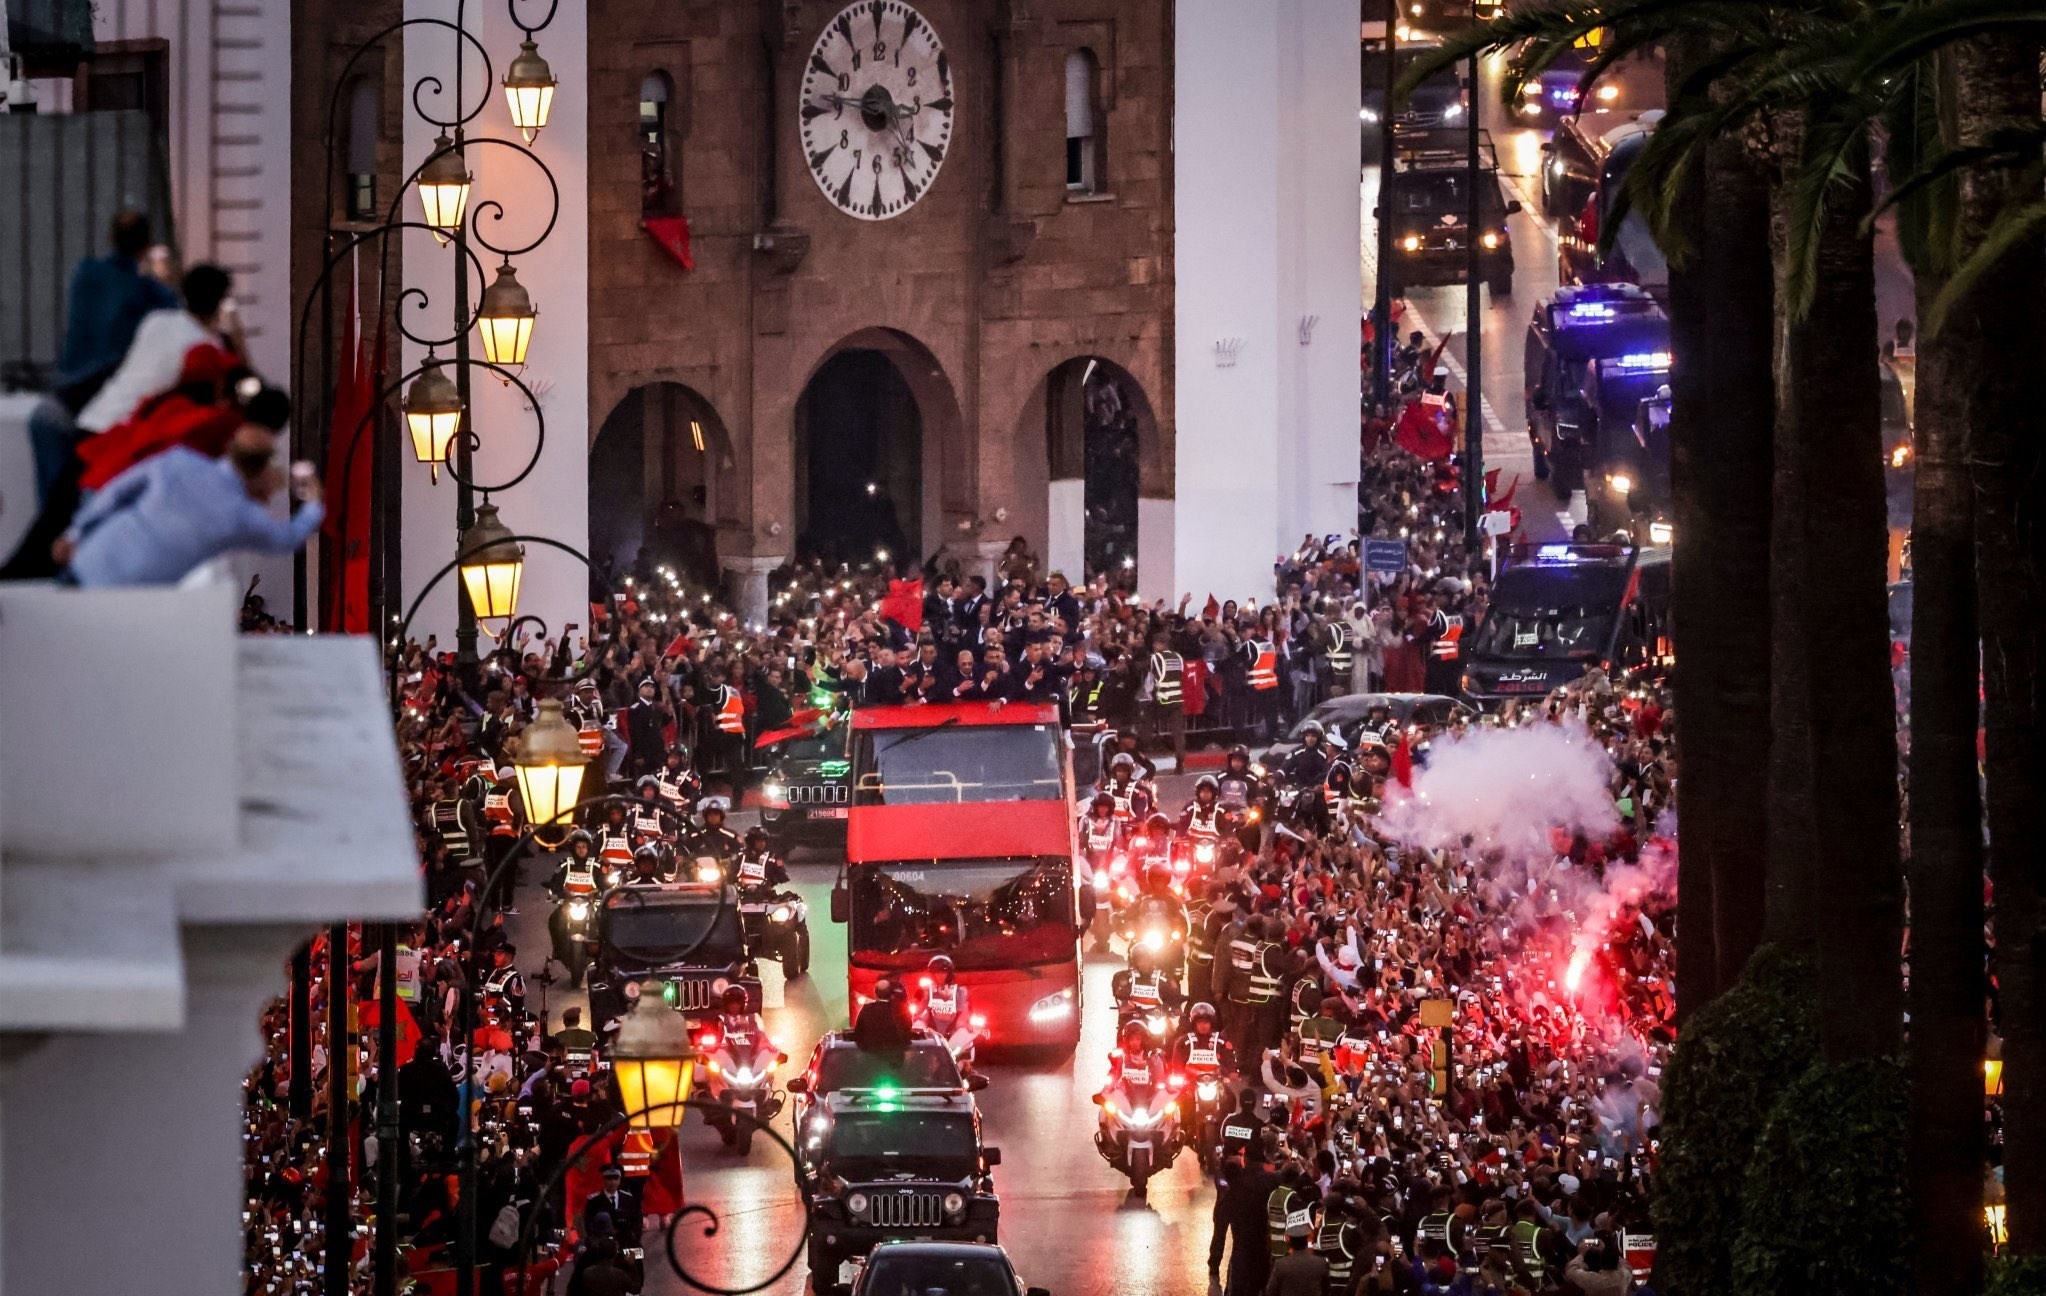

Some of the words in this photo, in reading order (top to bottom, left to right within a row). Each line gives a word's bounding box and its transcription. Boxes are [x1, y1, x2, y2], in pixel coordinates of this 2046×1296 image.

[852, 50, 861, 71] 11
[873, 42, 886, 61] 12
[894, 49, 900, 68] 1
[838, 73, 850, 92] 10
[907, 67, 916, 87] 2
[840, 129, 849, 149] 8
[906, 125, 914, 143] 4
[853, 150, 862, 169] 7
[872, 154, 882, 174] 6
[893, 148, 902, 167] 5
[1496, 682, 1545, 691] POLICE
[1499, 672, 1547, 683] الشرطة
